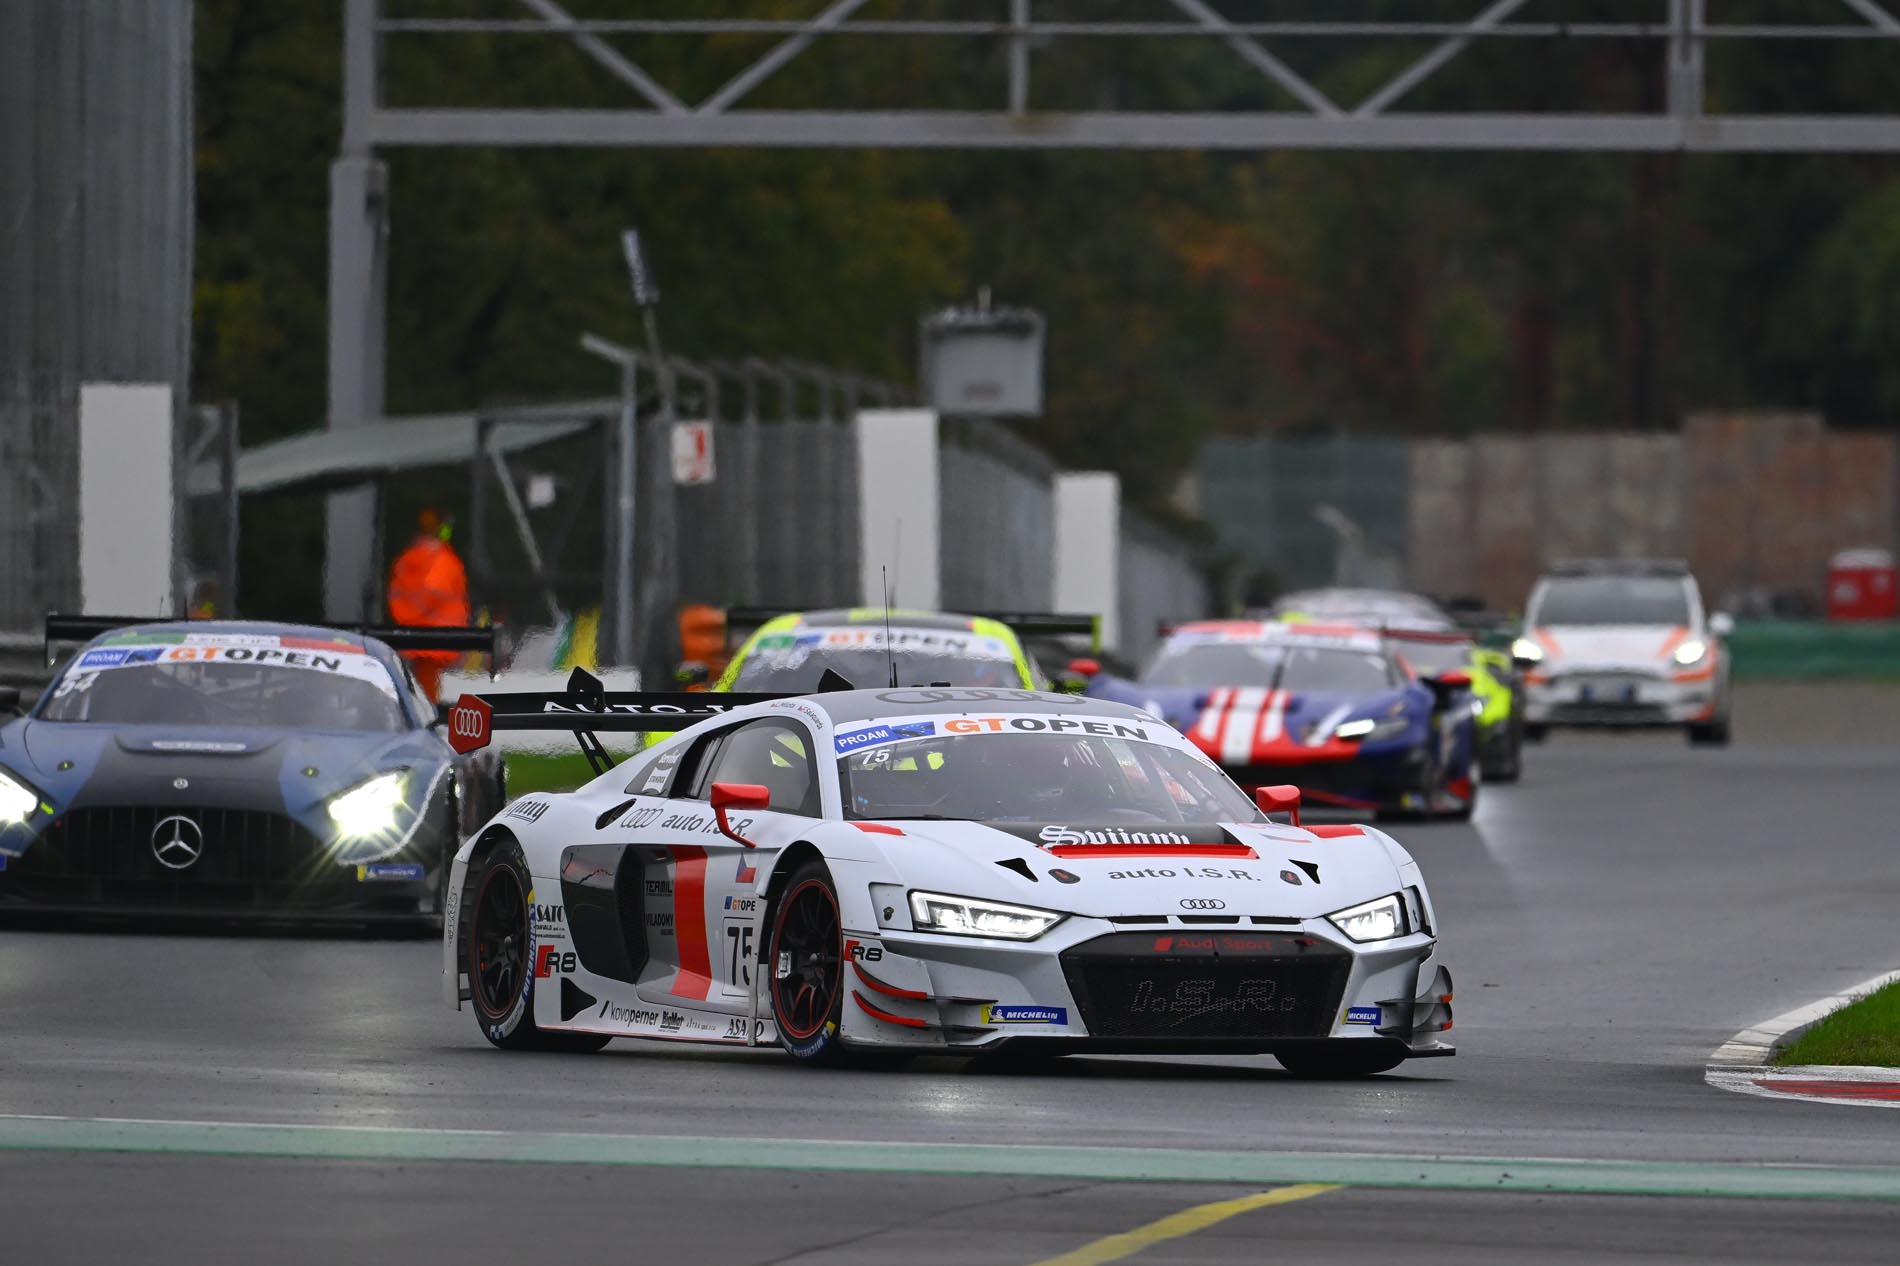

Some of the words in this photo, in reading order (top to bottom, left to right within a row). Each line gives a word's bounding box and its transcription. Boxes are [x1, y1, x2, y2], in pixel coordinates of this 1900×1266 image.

[837, 730, 889, 748] PROAM
[861, 749, 890, 766] 75
[662, 813, 703, 833] auto
[1107, 867, 1176, 880] auto
[1183, 867, 1262, 882] I.S.R.
[1177, 937, 1217, 949] Audi
[544, 952, 577, 973] R8
[728, 927, 753, 986] 75
[850, 946, 883, 962] R8
[610, 1001, 659, 1027] kovoperner
[1006, 1010, 1059, 1020] MICHELIN
[1349, 1012, 1377, 1020] MICHELIN
